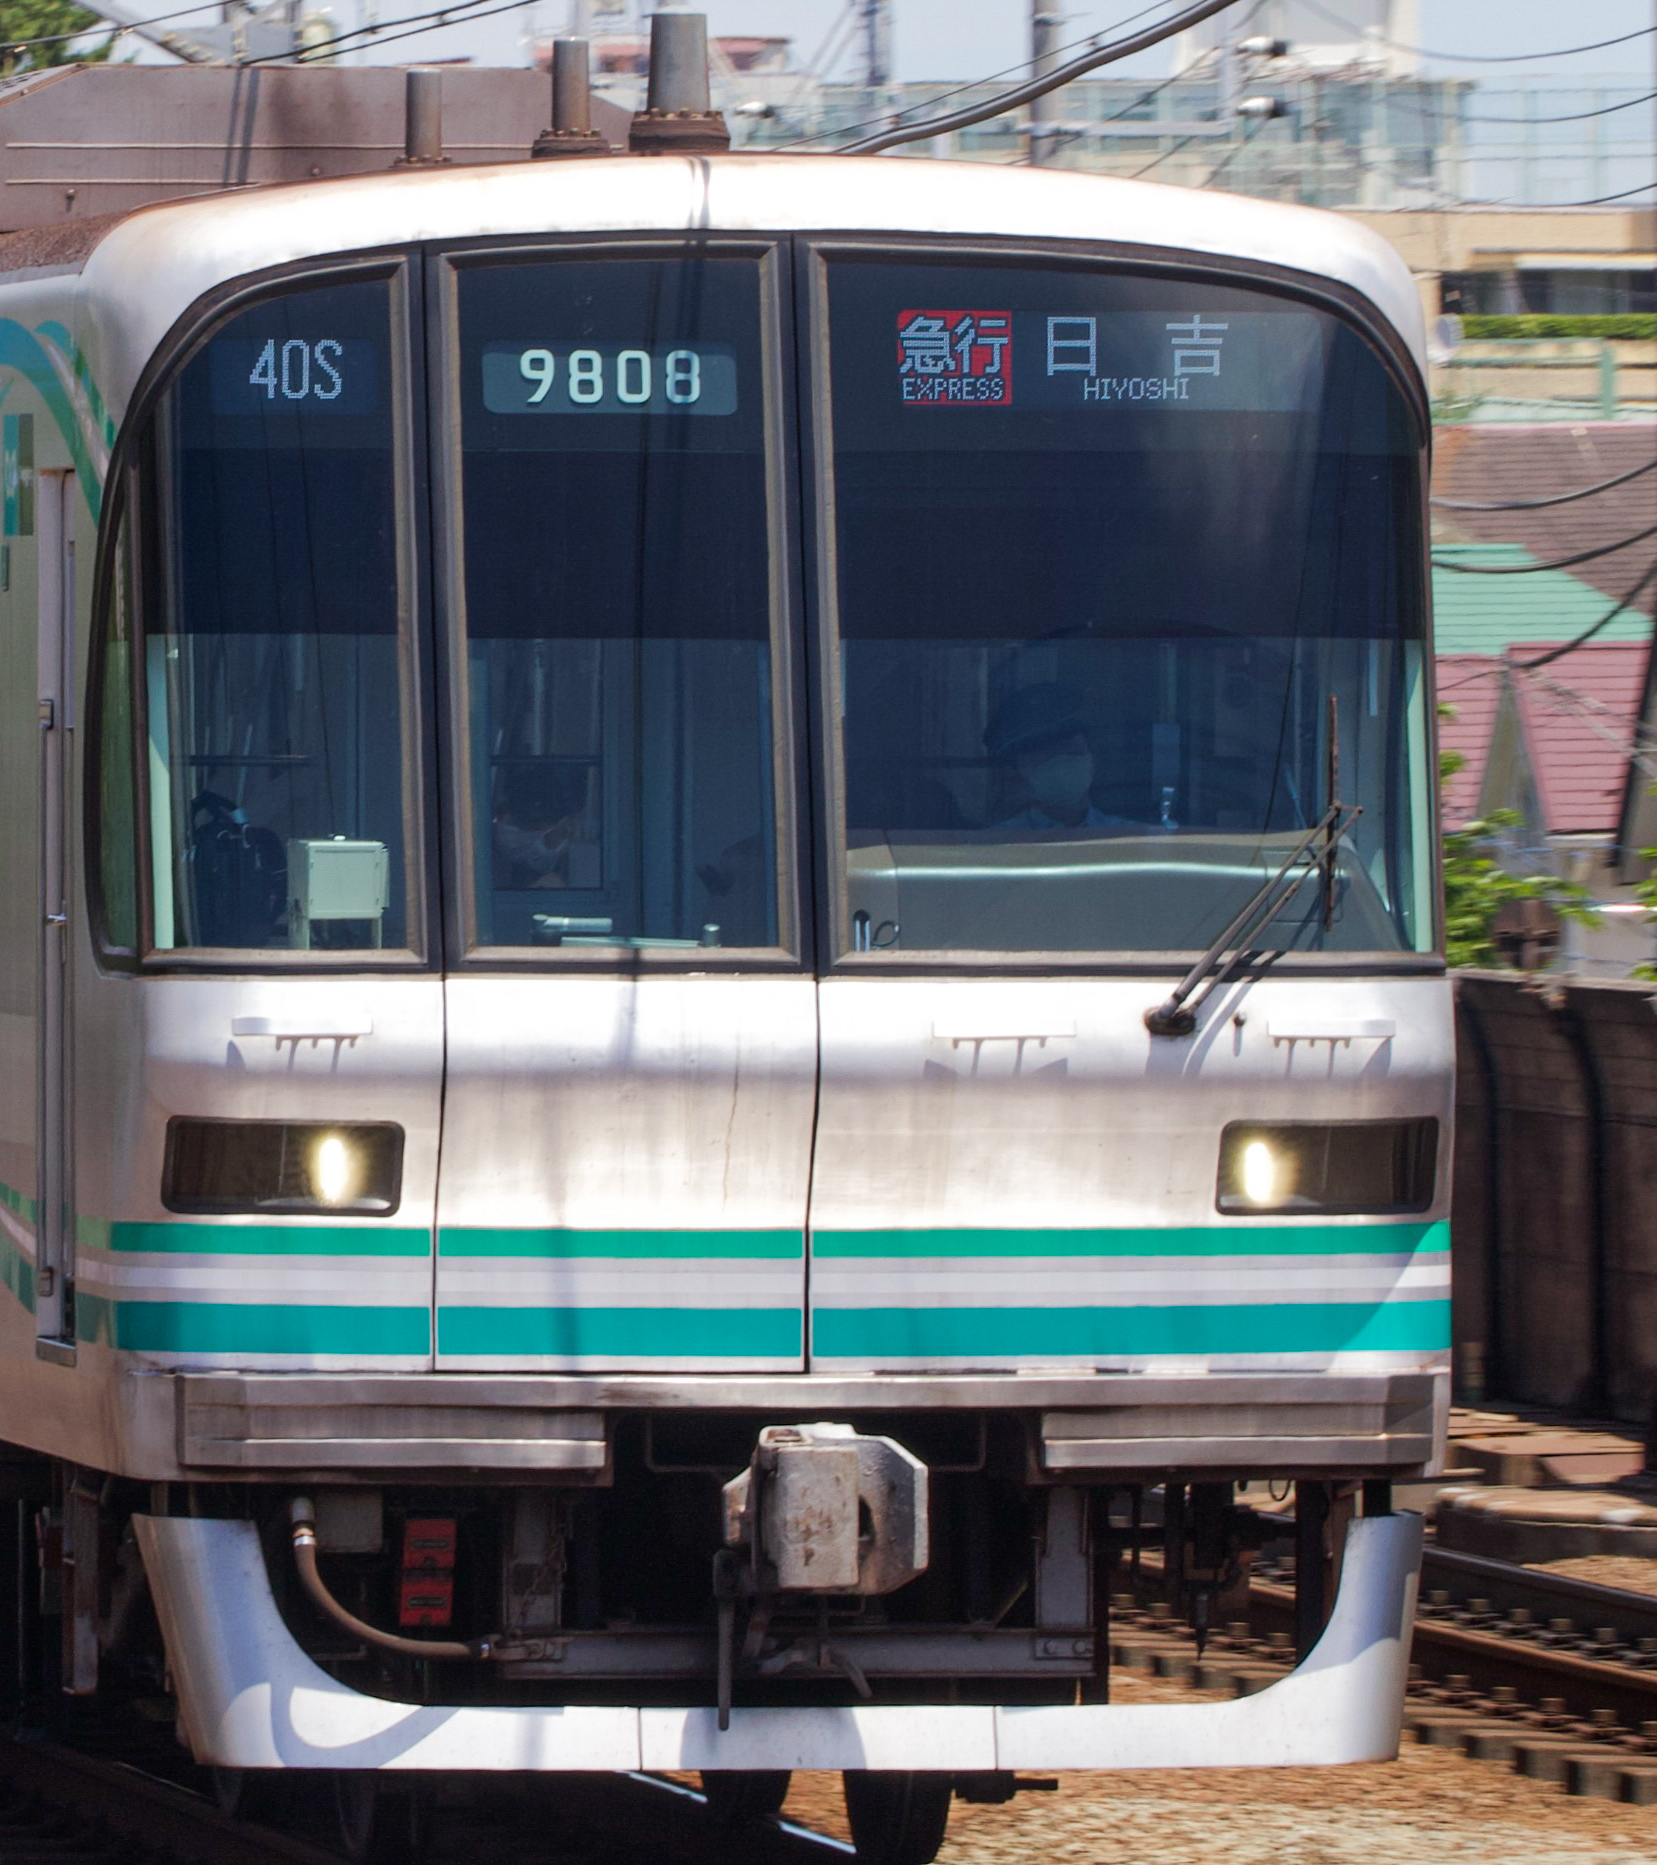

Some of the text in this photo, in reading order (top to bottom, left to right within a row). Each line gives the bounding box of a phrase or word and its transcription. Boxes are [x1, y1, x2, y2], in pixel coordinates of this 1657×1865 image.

[249, 339, 343, 400] 40S
[898, 315, 1010, 375] 急行
[1046, 314, 1229, 377] 日吉
[518, 349, 702, 404] 9808
[901, 377, 1004, 401] EXPRESS
[1083, 377, 1190, 401] HIYOSHI
